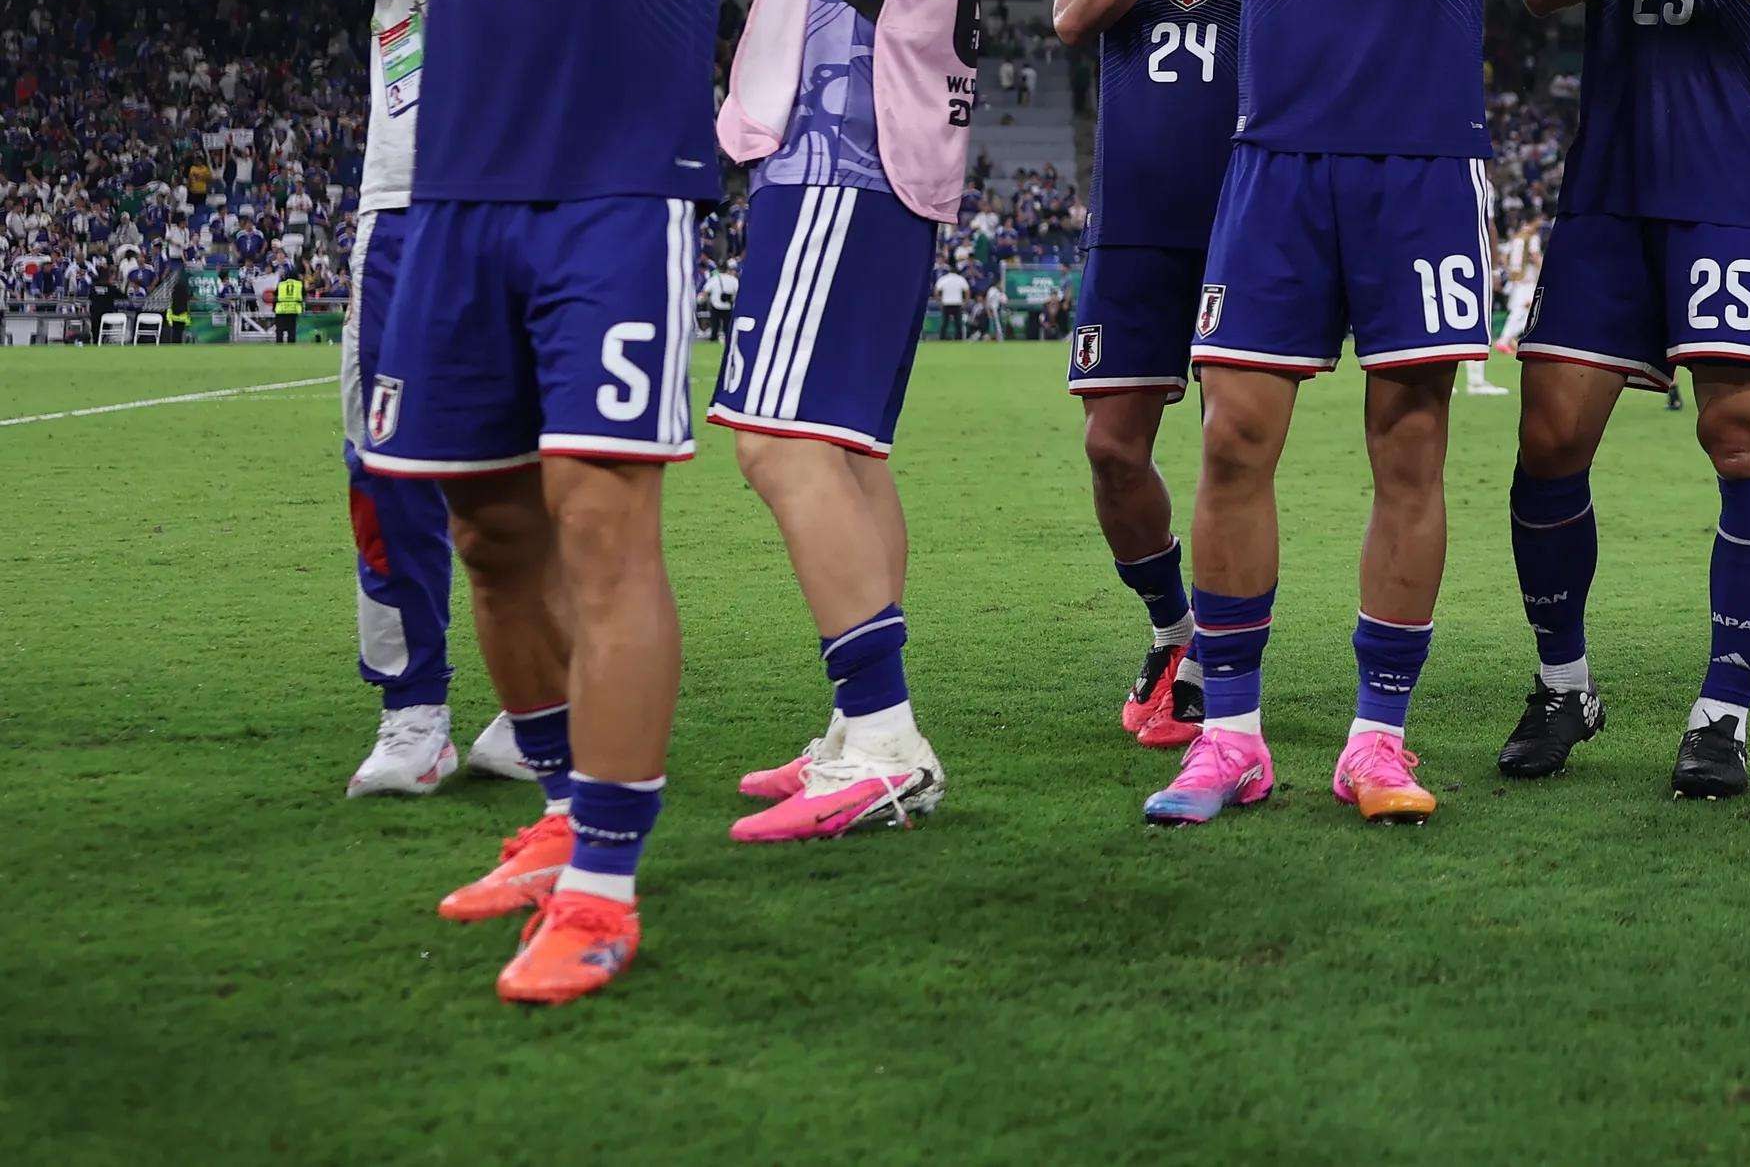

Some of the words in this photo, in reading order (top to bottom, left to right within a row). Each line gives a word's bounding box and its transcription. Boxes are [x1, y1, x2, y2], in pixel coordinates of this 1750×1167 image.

[1148, 22, 1218, 83] 24
[1413, 254, 1479, 334] 16
[596, 322, 656, 421] 5
